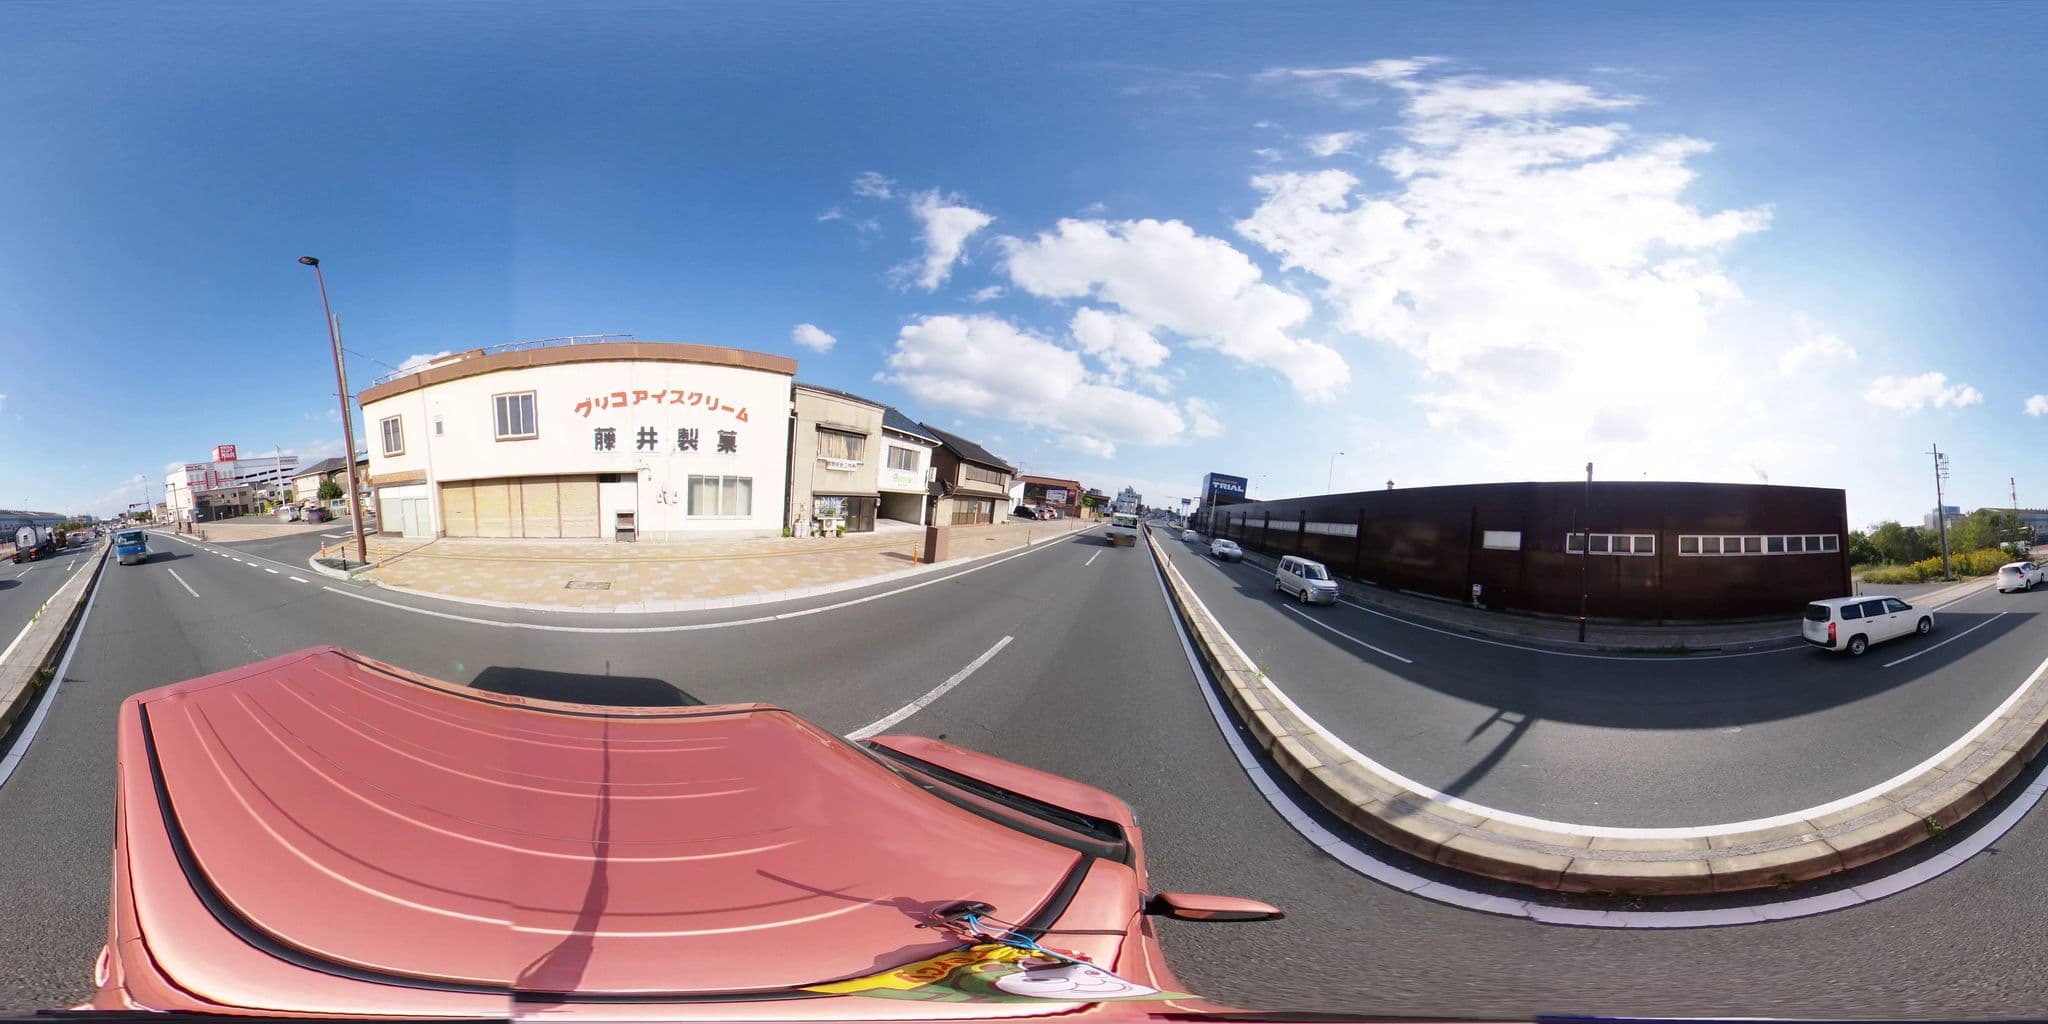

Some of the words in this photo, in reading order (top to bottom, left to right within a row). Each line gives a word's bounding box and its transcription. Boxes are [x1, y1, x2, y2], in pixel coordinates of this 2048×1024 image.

[574, 389, 749, 423] グリコアイスクリーム
[594, 426, 738, 454] 藤井製菓
[1212, 481, 1244, 493] TRIAL
